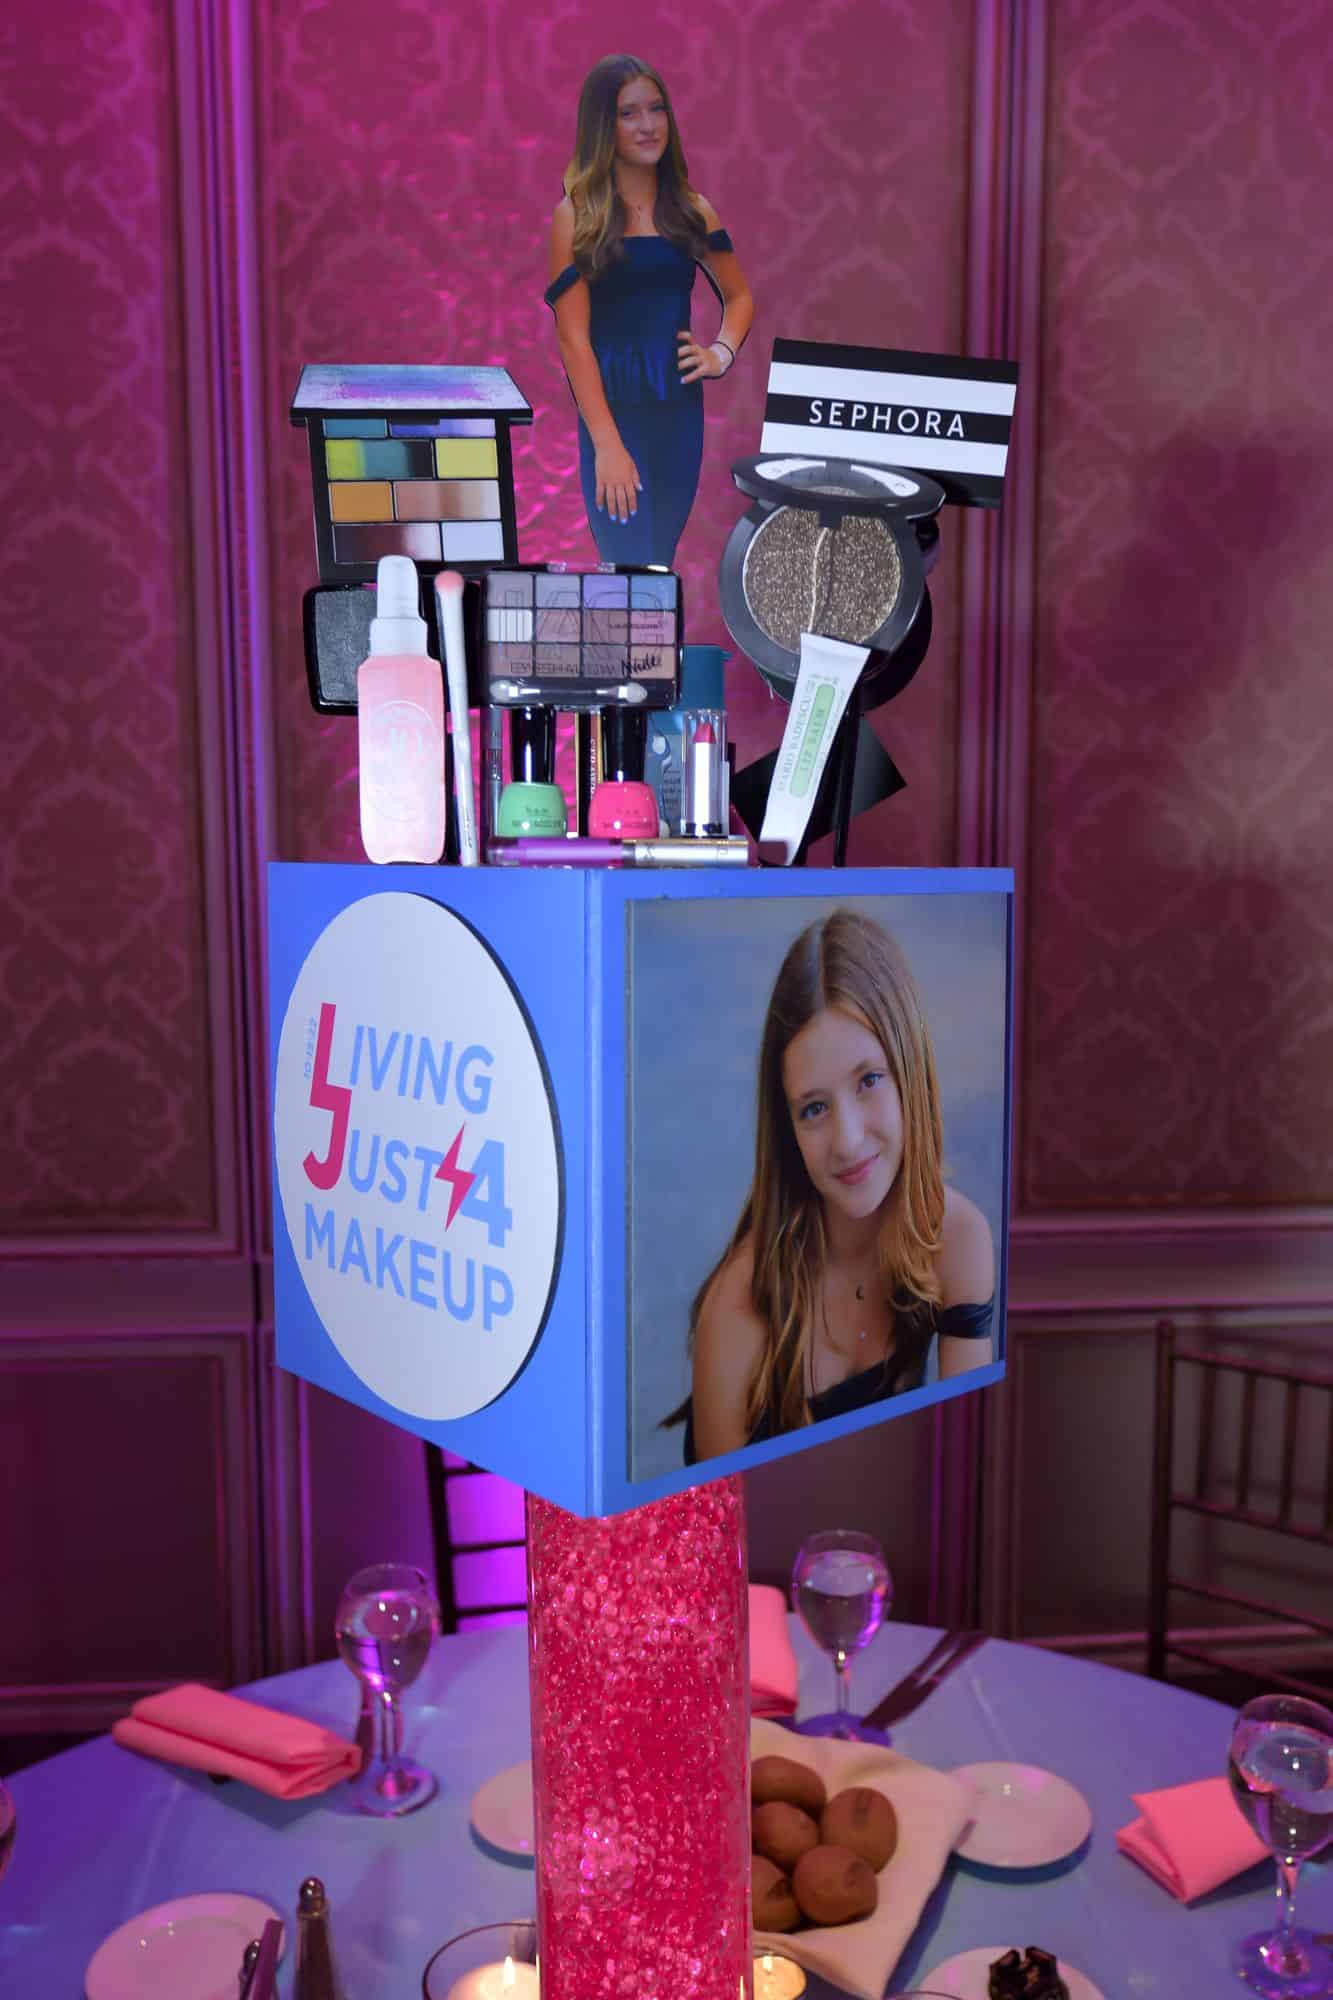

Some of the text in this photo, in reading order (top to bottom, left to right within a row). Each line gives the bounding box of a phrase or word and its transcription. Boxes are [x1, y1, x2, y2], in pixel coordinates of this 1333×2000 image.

[809, 400, 964, 438] SEPHORA
[310, 1002, 494, 1114] LIVING
[303, 1088, 513, 1248] JUST 4
[304, 1202, 515, 1332] MAKEUP
